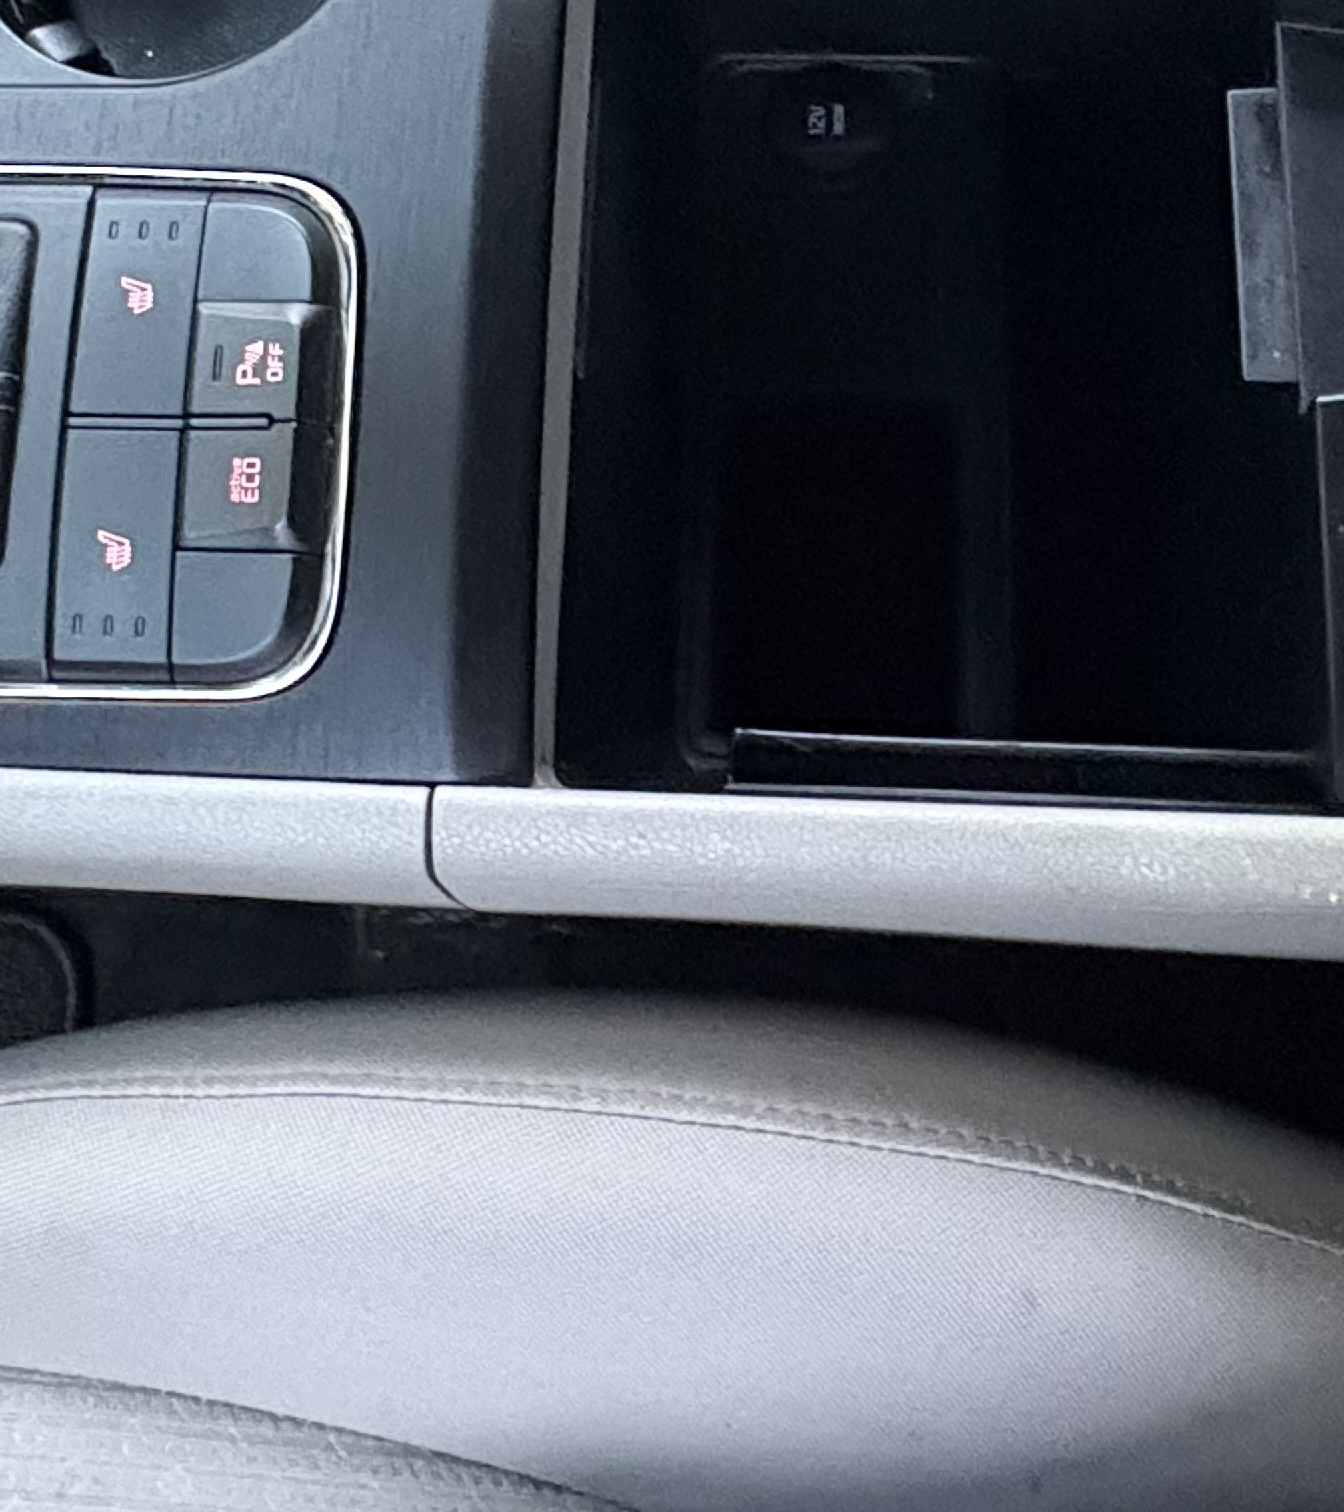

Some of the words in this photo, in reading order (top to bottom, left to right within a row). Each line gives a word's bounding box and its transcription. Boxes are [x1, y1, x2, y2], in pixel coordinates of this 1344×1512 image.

[808, 104, 826, 136] 12V
[266, 341, 285, 383] OFF
[229, 456, 243, 504] active
[241, 456, 262, 504] ECO
